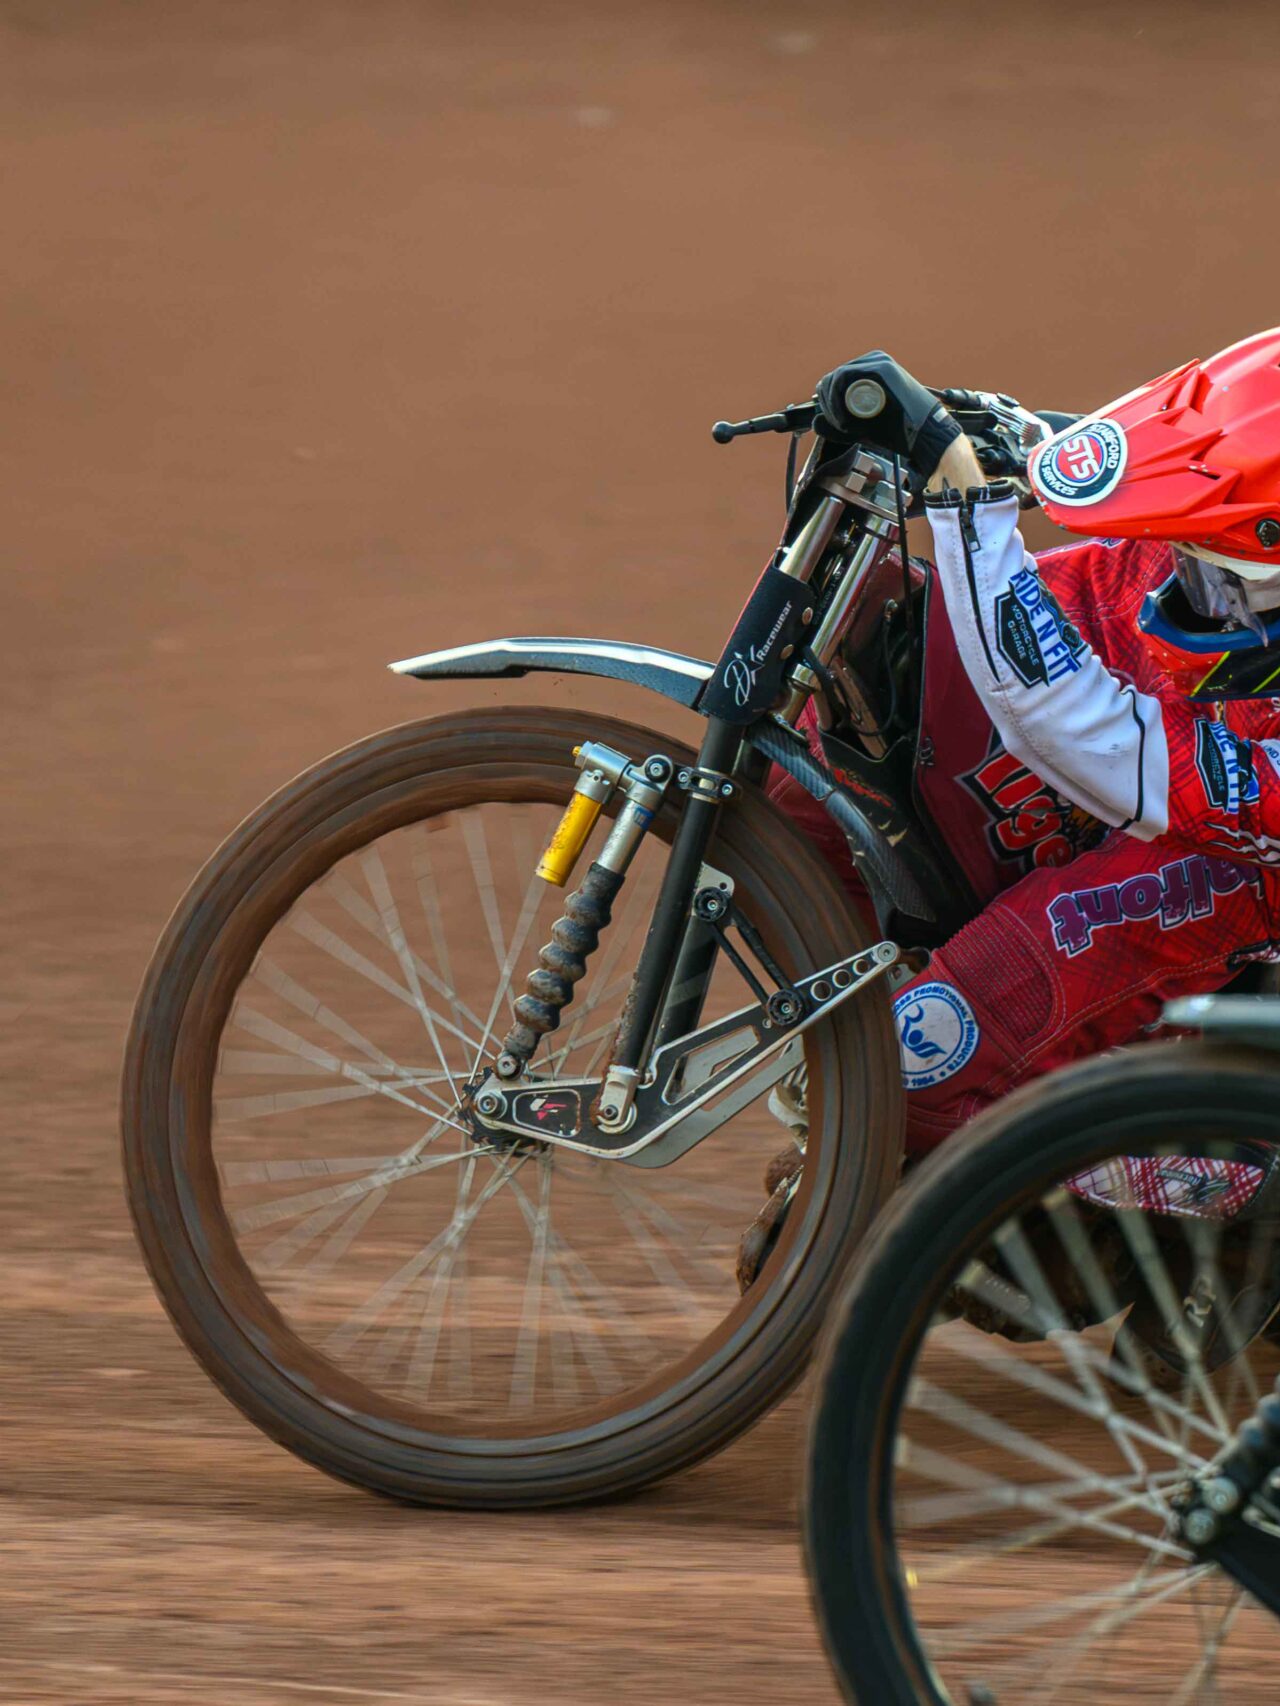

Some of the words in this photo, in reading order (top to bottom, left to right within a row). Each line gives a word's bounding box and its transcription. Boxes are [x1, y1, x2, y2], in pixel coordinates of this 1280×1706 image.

[1042, 466, 1079, 496] SERVICES
[1063, 434, 1100, 480] STS
[1010, 569, 1045, 620] RIDE
[756, 600, 793, 662] Racewear
[1007, 620, 1027, 660] GARAGE
[1010, 604, 1040, 667] MOTORCYCLE
[1036, 618, 1058, 643] N
[1043, 640, 1080, 682] FIT
[1046, 853, 1252, 957] alfont
[914, 985, 968, 1019] PROMOTIONAL
[947, 1019, 976, 1072] PRODUCTS
